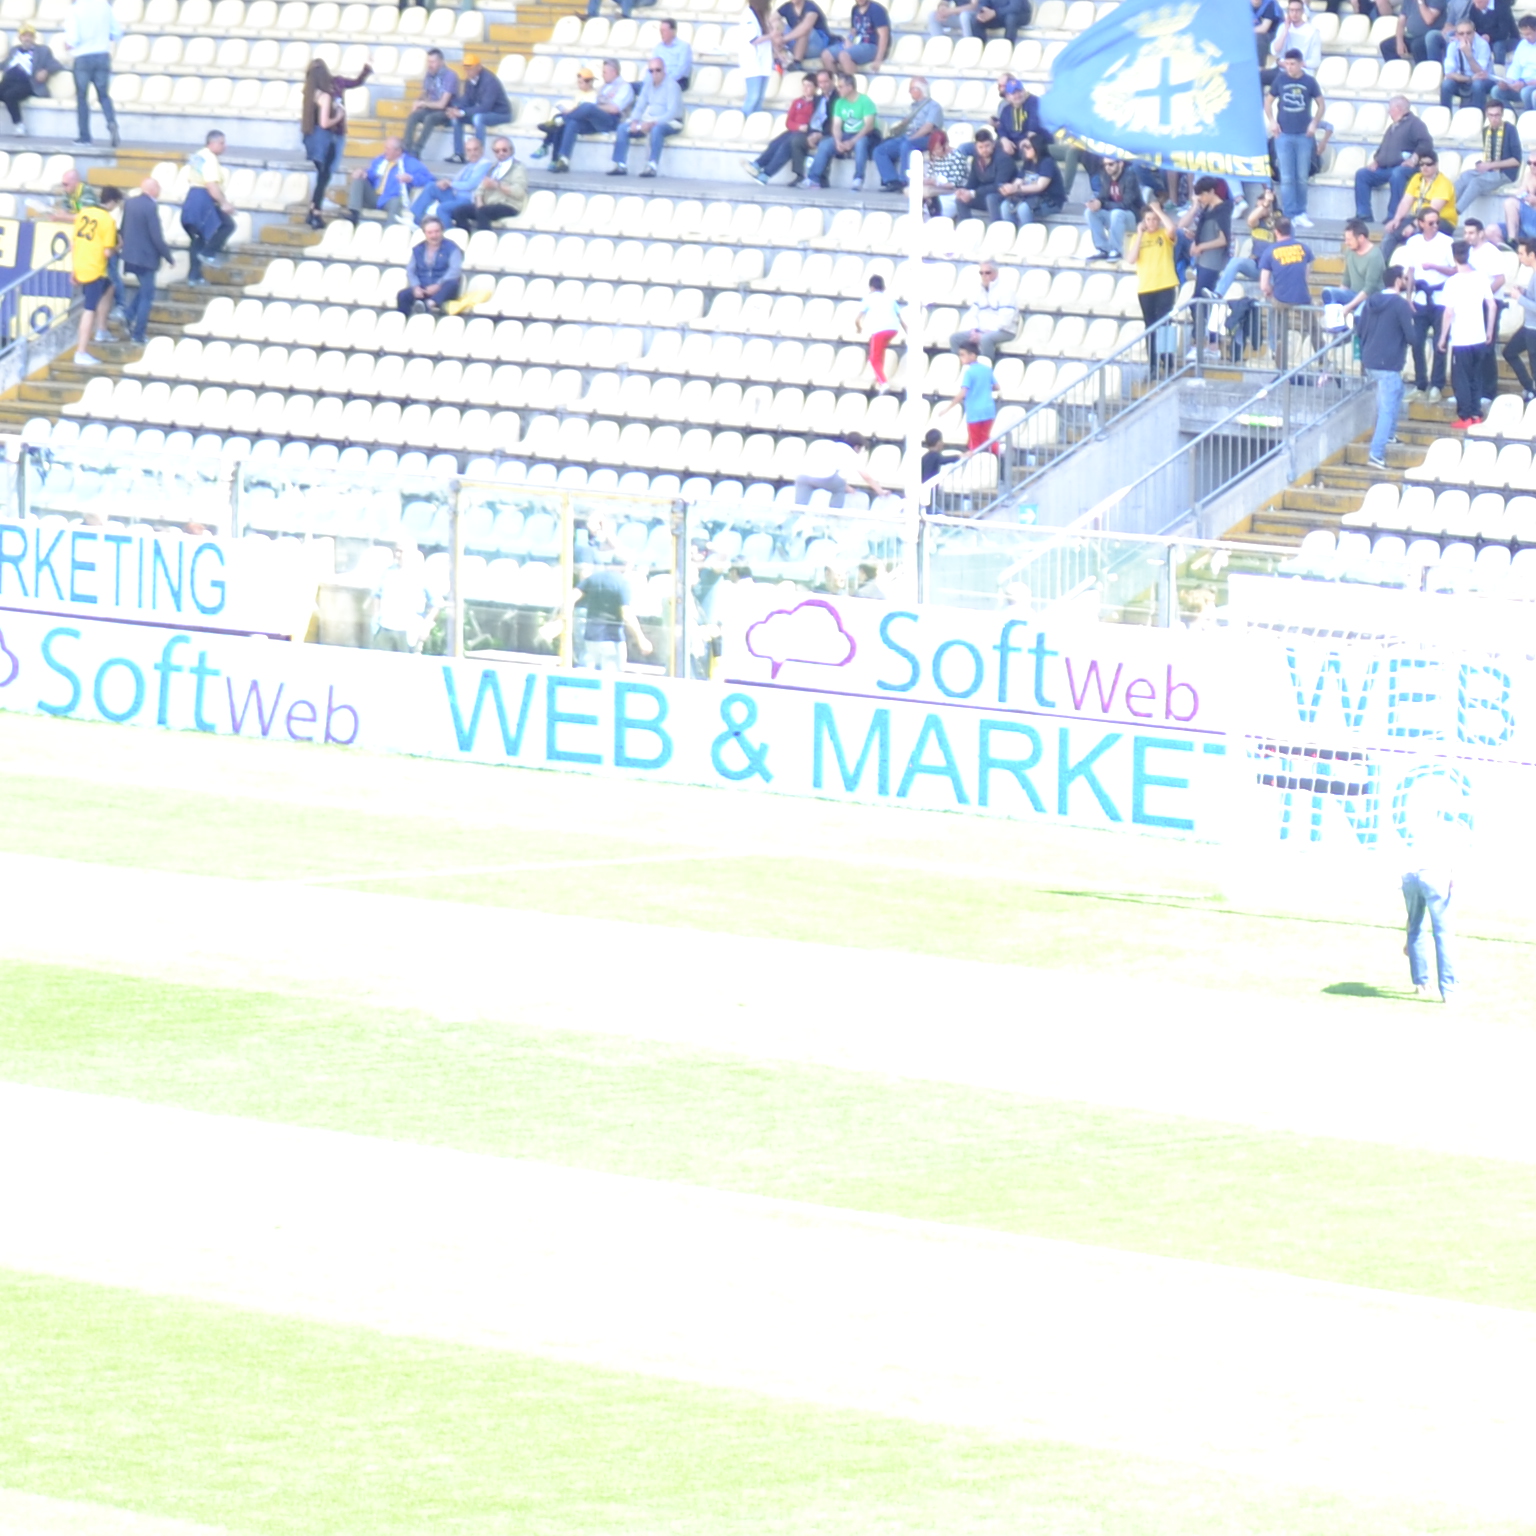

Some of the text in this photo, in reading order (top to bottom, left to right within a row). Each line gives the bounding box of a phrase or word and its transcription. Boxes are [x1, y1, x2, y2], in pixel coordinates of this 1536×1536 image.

[76, 215, 98, 241] 23
[441, 665, 674, 770] WEB
[709, 692, 775, 784] &
[1285, 647, 1516, 746] WEB
